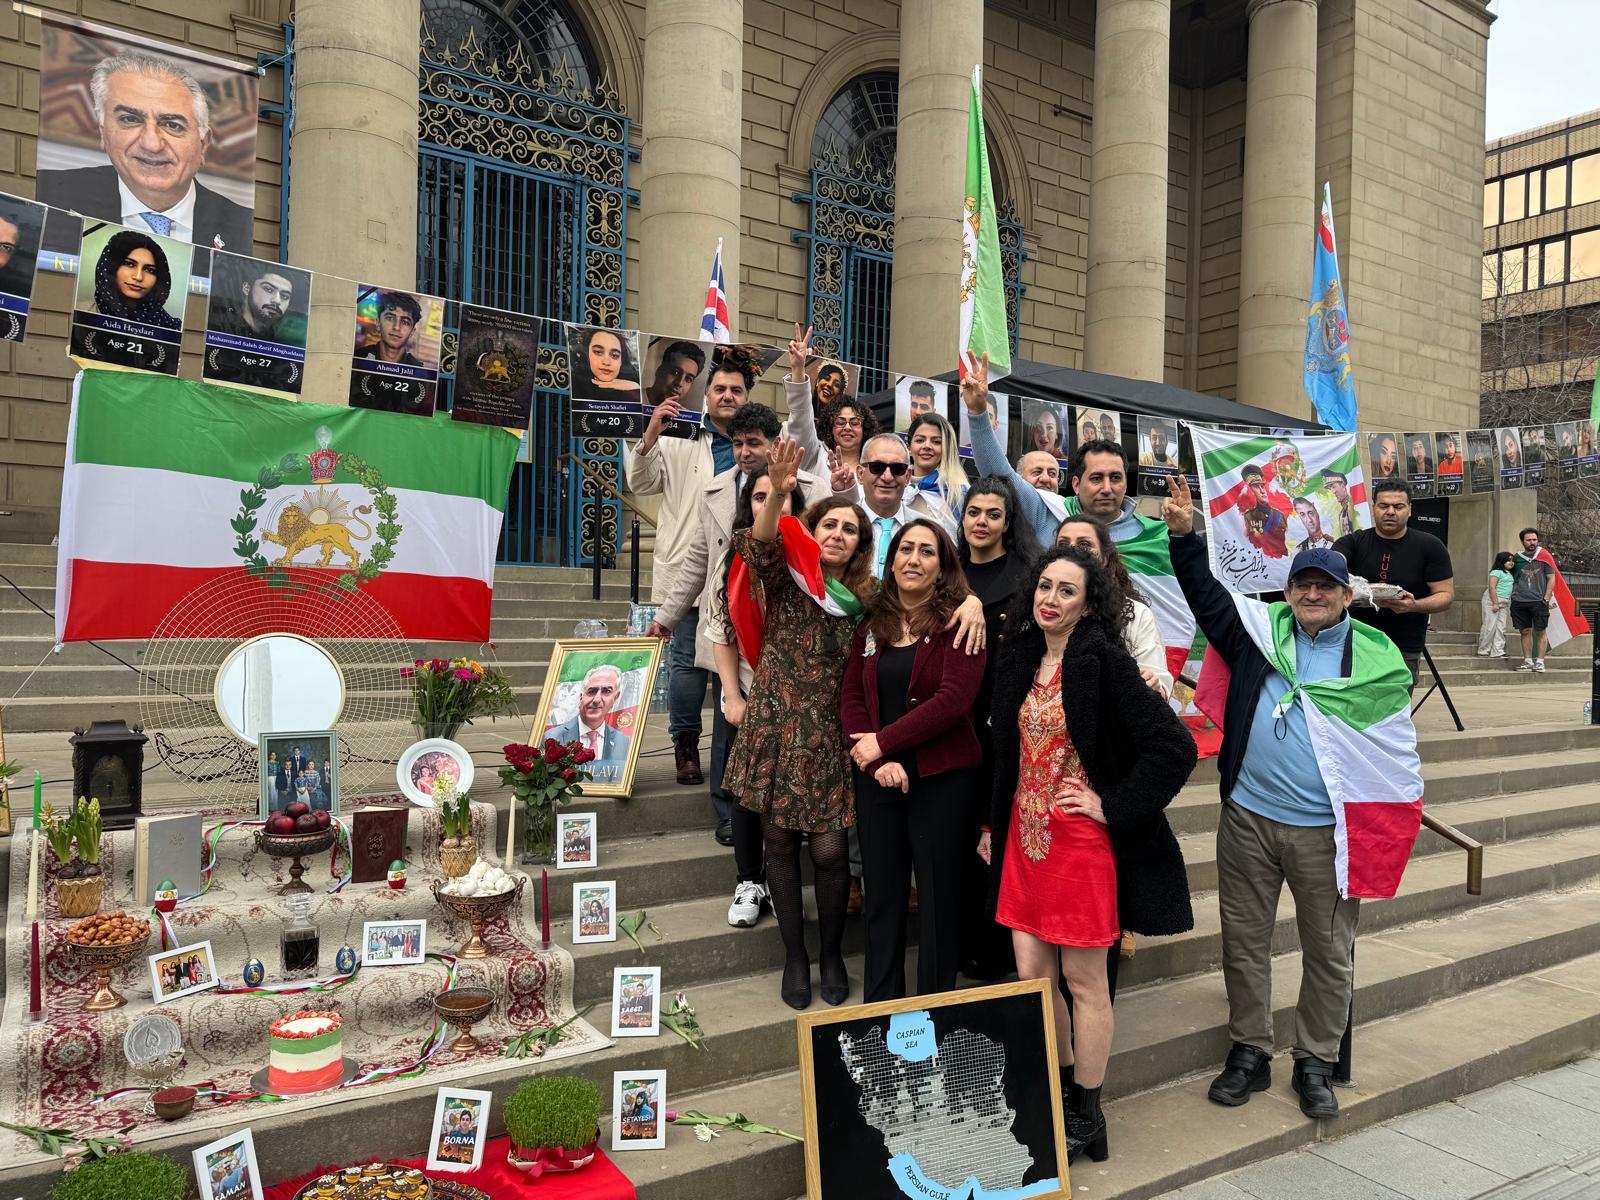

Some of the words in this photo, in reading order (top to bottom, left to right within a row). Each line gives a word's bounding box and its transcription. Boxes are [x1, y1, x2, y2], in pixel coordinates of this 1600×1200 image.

[102, 319, 121, 329] Aida
[123, 323, 154, 336] Heydari
[107, 338, 125, 349] Age
[126, 341, 144, 354] 21
[240, 355, 257, 366] Age
[259, 358, 272, 368] 27
[376, 364, 400, 373] Ahmad
[400, 367, 414, 375] Jalil
[380, 380, 393, 389] Age
[394, 381, 409, 392] 22
[595, 417, 608, 425] Age
[608, 417, 620, 426] 20
[1380, 553, 1391, 583] HUG
[564, 845, 586, 853] SAAM
[582, 916, 604, 925] SARA
[896, 1027, 926, 1040] CASPIAN
[904, 1040, 918, 1050] SEA
[443, 1136, 475, 1145] BORNA
[904, 1164, 929, 1195] PERSIAN
[929, 1189, 951, 1200] GULF
